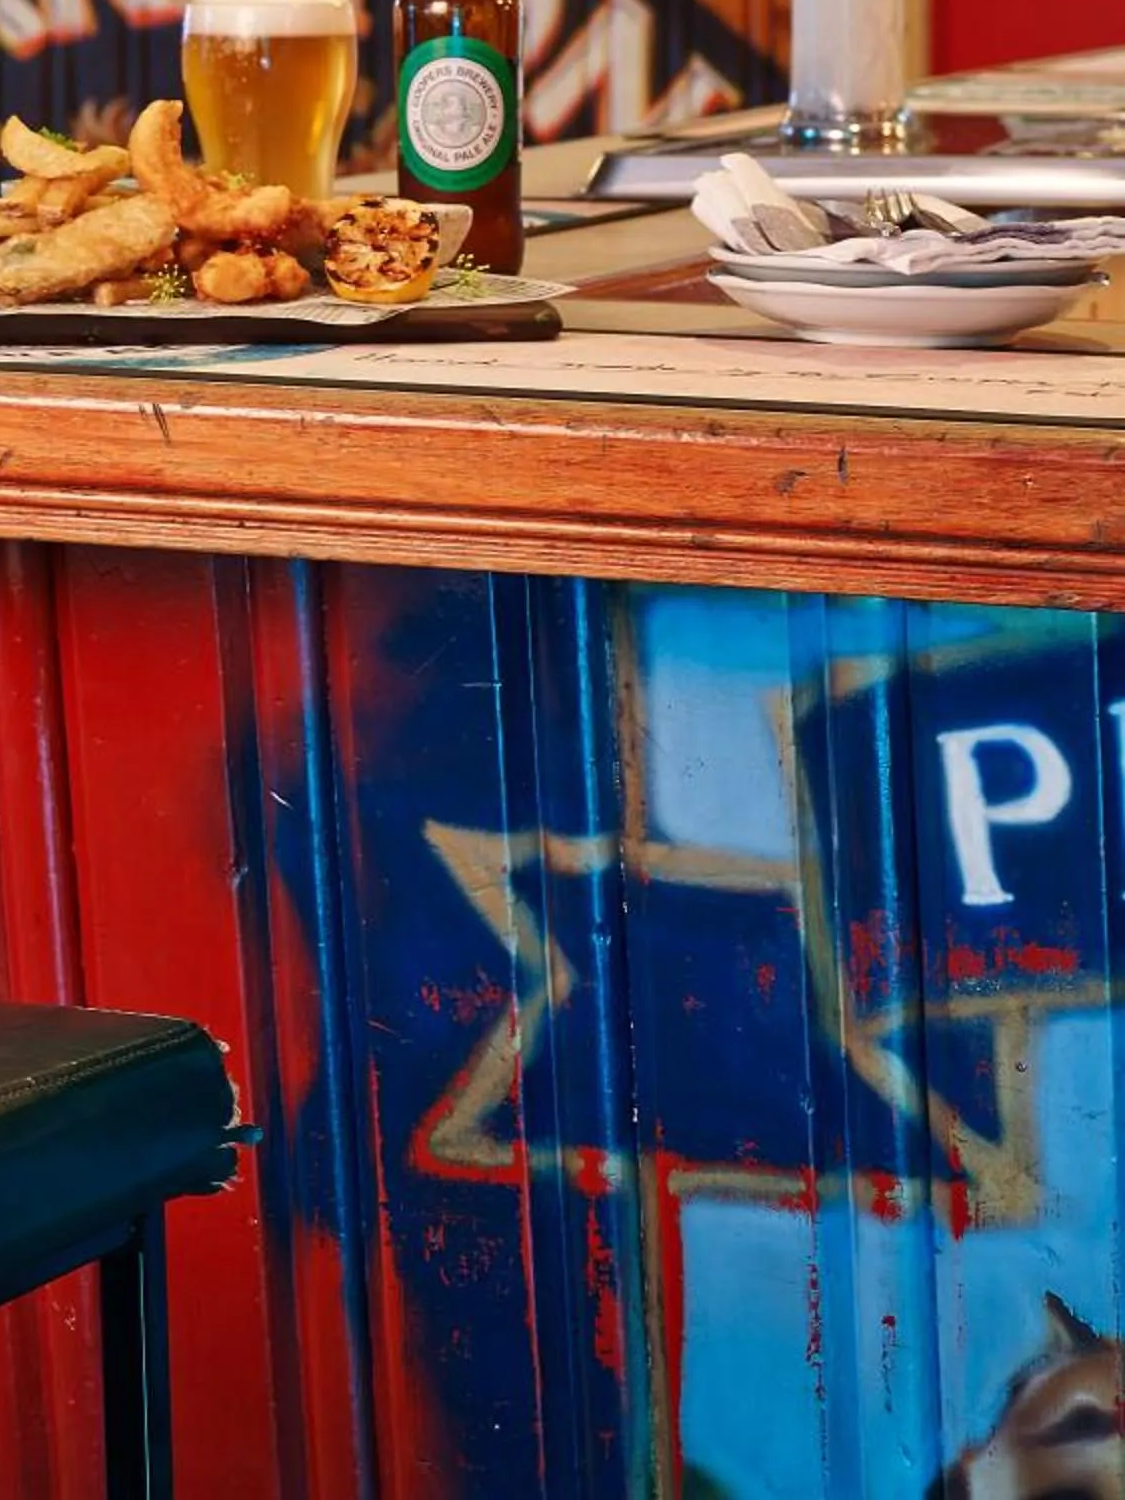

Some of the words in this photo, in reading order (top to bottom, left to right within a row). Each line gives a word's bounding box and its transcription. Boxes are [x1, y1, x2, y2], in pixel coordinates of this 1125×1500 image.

[411, 65, 453, 108] COOPERS
[456, 65, 498, 110] BREWERY
[453, 143, 482, 163] PALE
[482, 124, 499, 146] ALE
